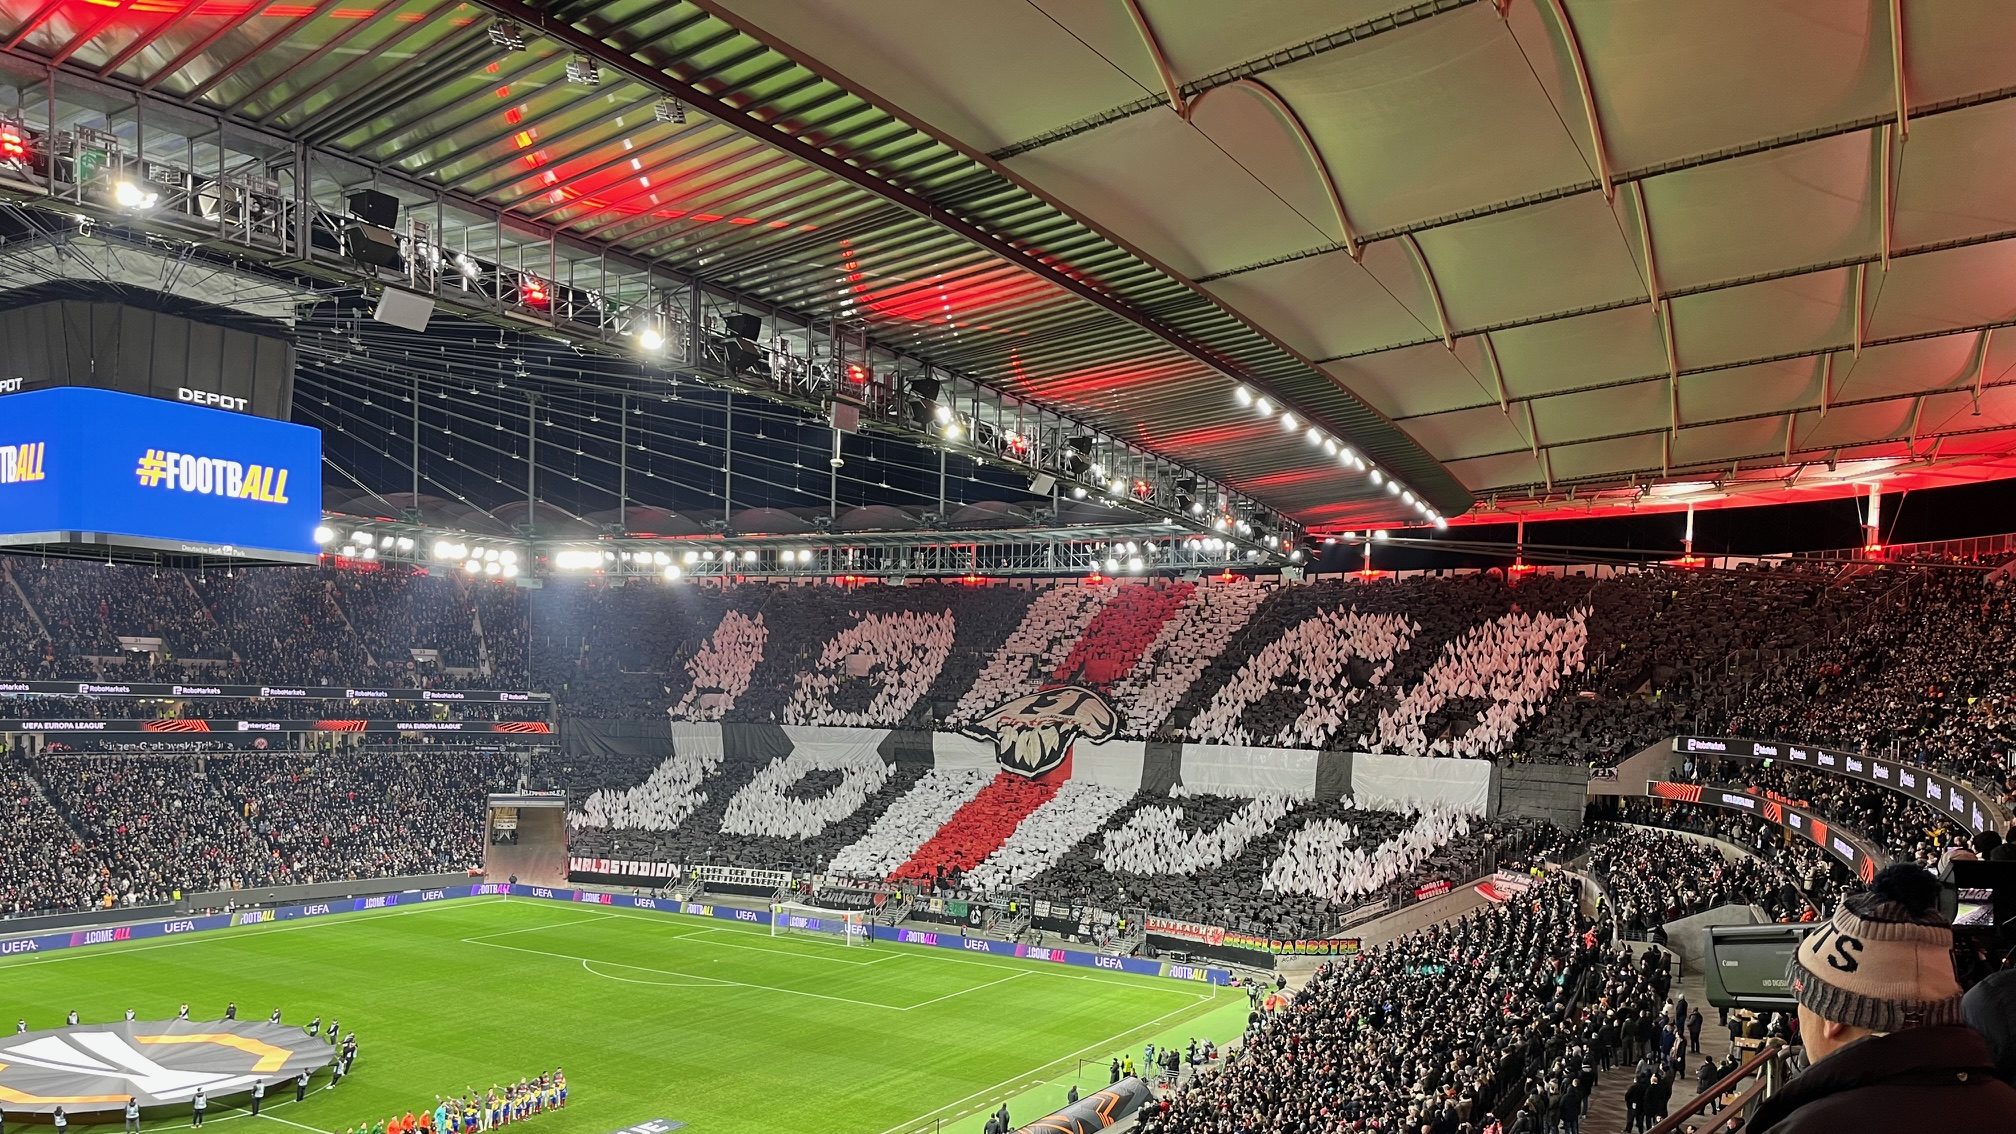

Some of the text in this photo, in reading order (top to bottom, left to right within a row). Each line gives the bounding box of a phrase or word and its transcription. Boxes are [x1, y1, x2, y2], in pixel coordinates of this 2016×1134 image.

[178, 387, 248, 411] DEPOT
[136, 449, 288, 504] #FOOTBALL
[181, 544, 208, 554] Deutsche
[89, 685, 130, 693] RoboMarkets
[270, 688, 306, 696] RoboMarkets
[354, 690, 388, 698] RoboMarkets
[22, 722, 44, 730] UEFA
[44, 722, 74, 730] EUROPA
[569, 857, 681, 878] WALDSTADION
[532, 887, 553, 898] UEFA
[600, 893, 612, 905] ALL
[819, 888, 872, 906] Eintracht
[385, 895, 398, 906] ALL
[634, 897, 655, 909] UEFA
[303, 904, 330, 916] UEFA
[735, 909, 758, 922] UEFA
[164, 920, 194, 933] UEFA
[808, 917, 821, 930] ALL
[844, 924, 867, 936] UEFA
[1149, 919, 1214, 937] EINTRACHT
[113, 927, 131, 941] ALL
[2, 940, 35, 954] UEFA
[964, 938, 990, 952] UEFA
[1050, 949, 1066, 963] ALL
[1094, 956, 1123, 970] UEFA
